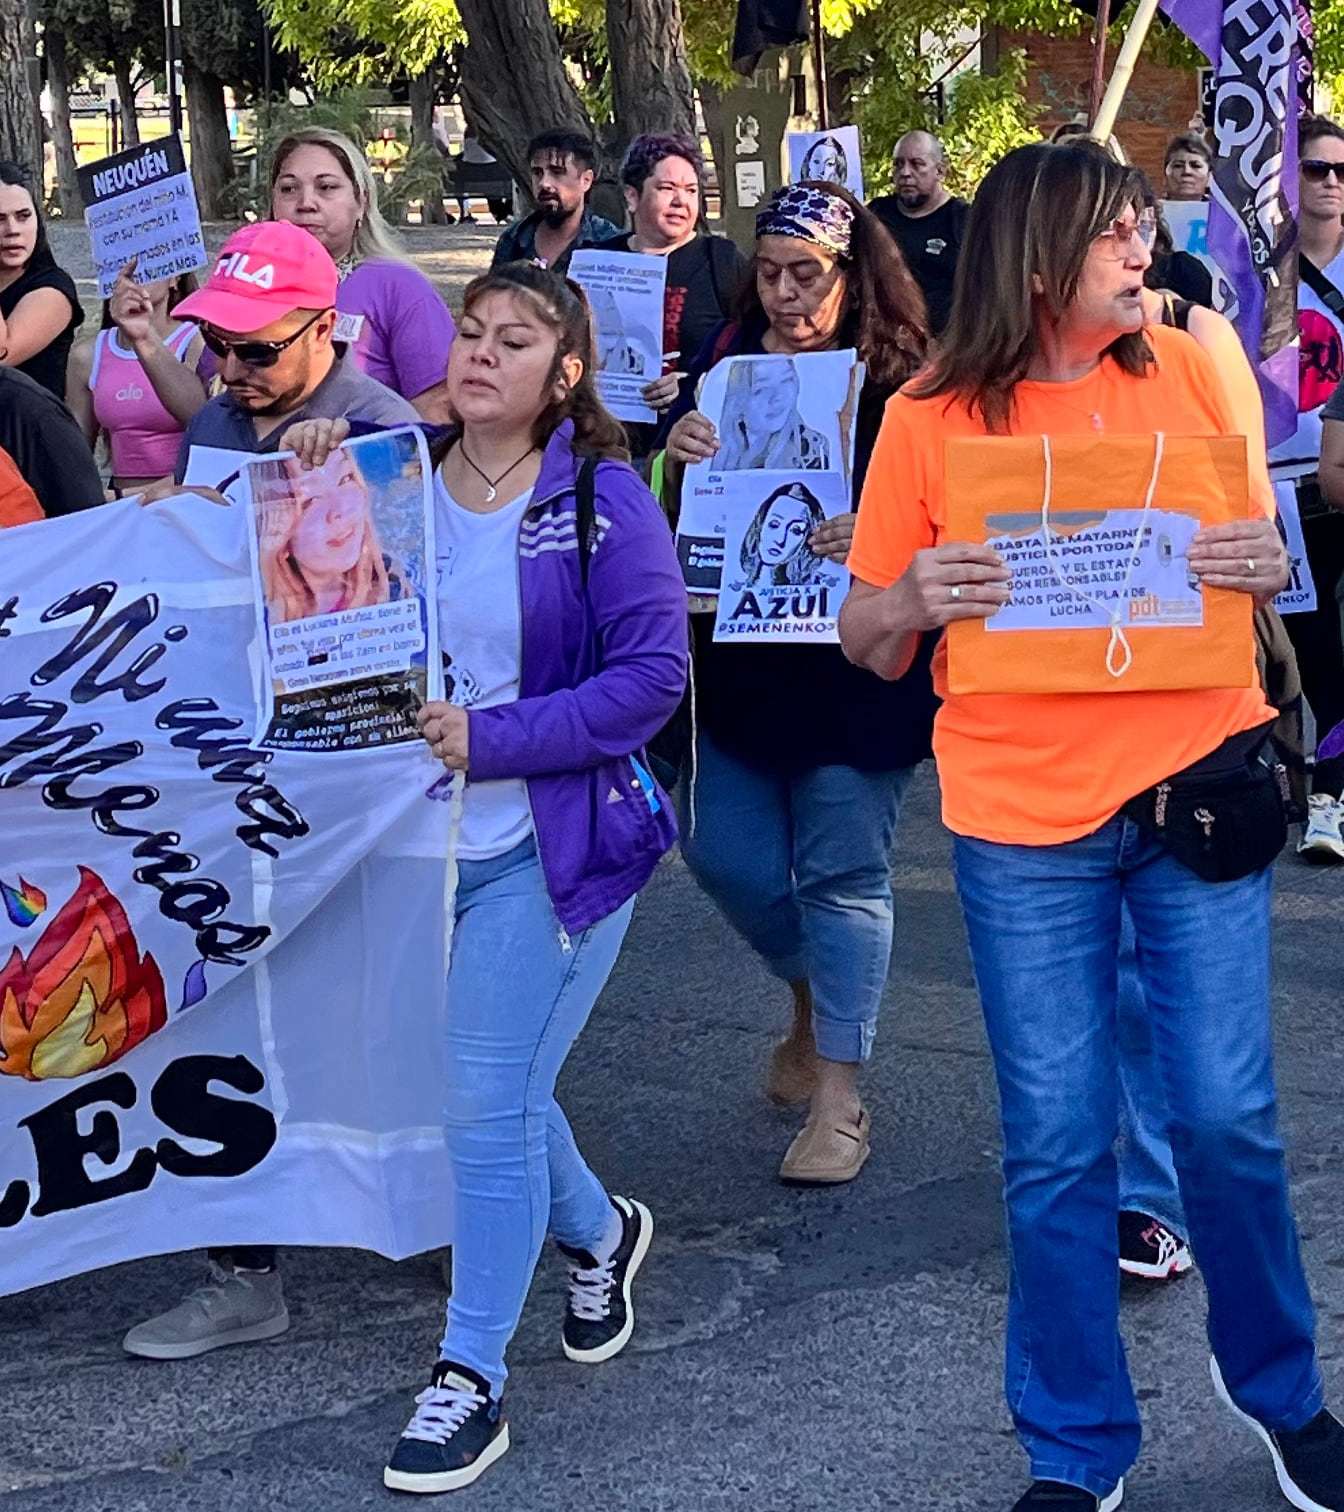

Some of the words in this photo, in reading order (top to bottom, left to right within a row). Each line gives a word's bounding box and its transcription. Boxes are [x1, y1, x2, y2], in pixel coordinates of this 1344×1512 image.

[92, 147, 170, 198] NEUQUÉN
[214, 252, 274, 289] FILA
[994, 537, 1041, 551] BASTA
[1062, 545, 1094, 556] POR
[1061, 564, 1070, 574] Y
[1074, 562, 1087, 574] EL
[1004, 596, 1043, 607] AMOS
[1047, 592, 1072, 604] POR
[1050, 605, 1093, 617] LUCHA
[155, 697, 310, 859] una
